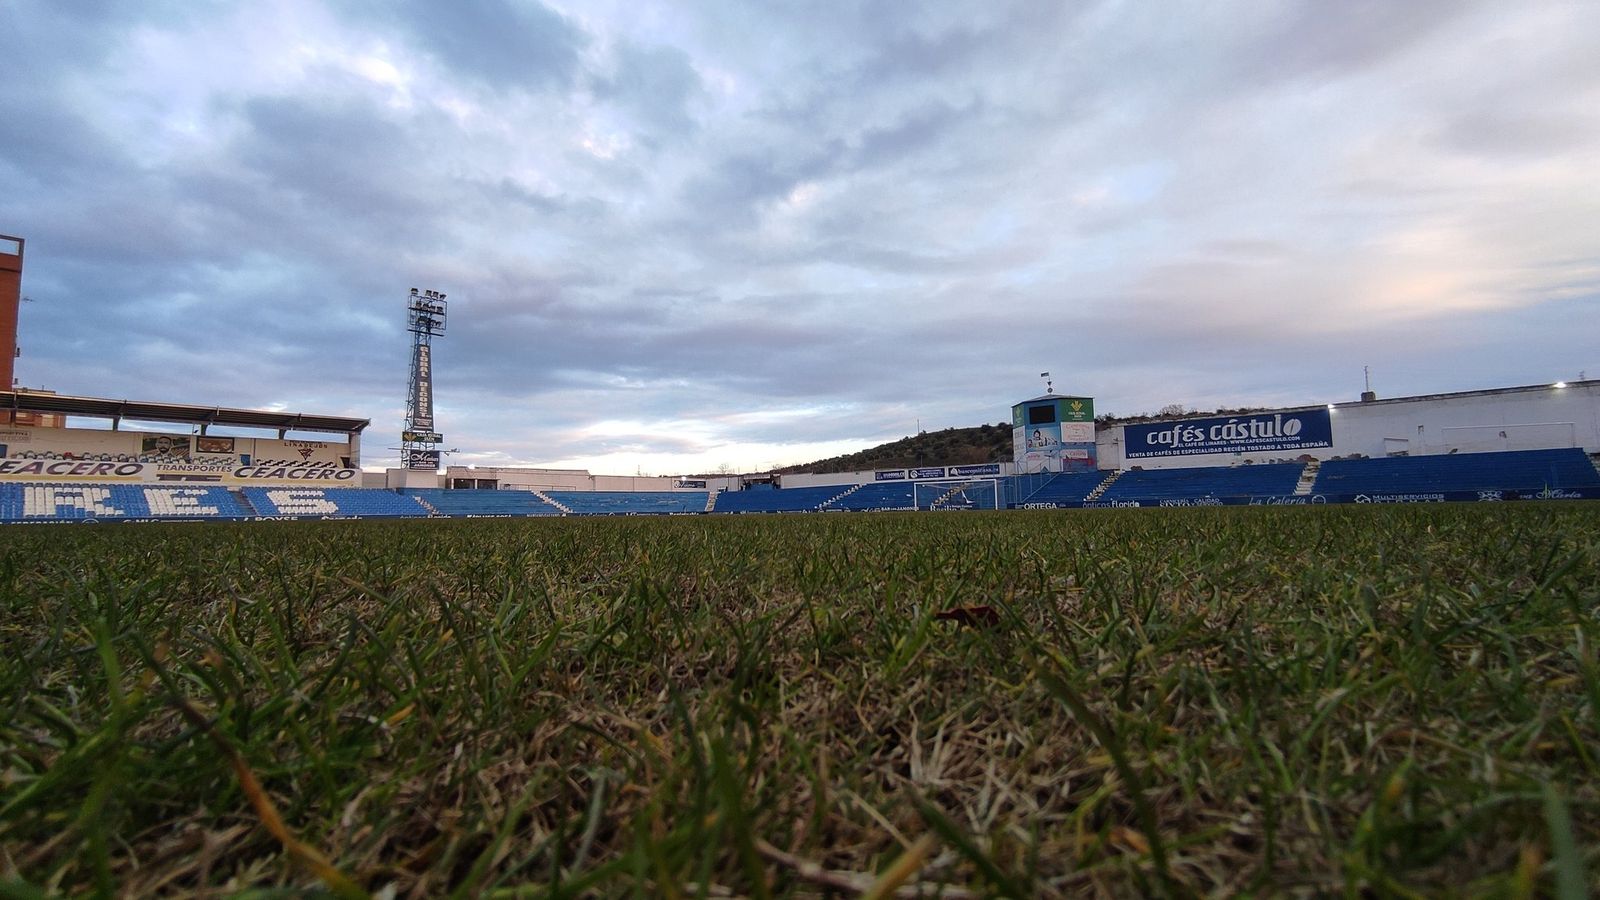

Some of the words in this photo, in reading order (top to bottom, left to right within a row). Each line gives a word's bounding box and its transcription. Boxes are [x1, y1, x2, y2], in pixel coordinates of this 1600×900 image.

[1146, 425, 1204, 448] cafés
[1210, 414, 1302, 440] cástulo
[156, 464, 232, 473] TRANSPORTES
[234, 466, 356, 480] CEACERO
